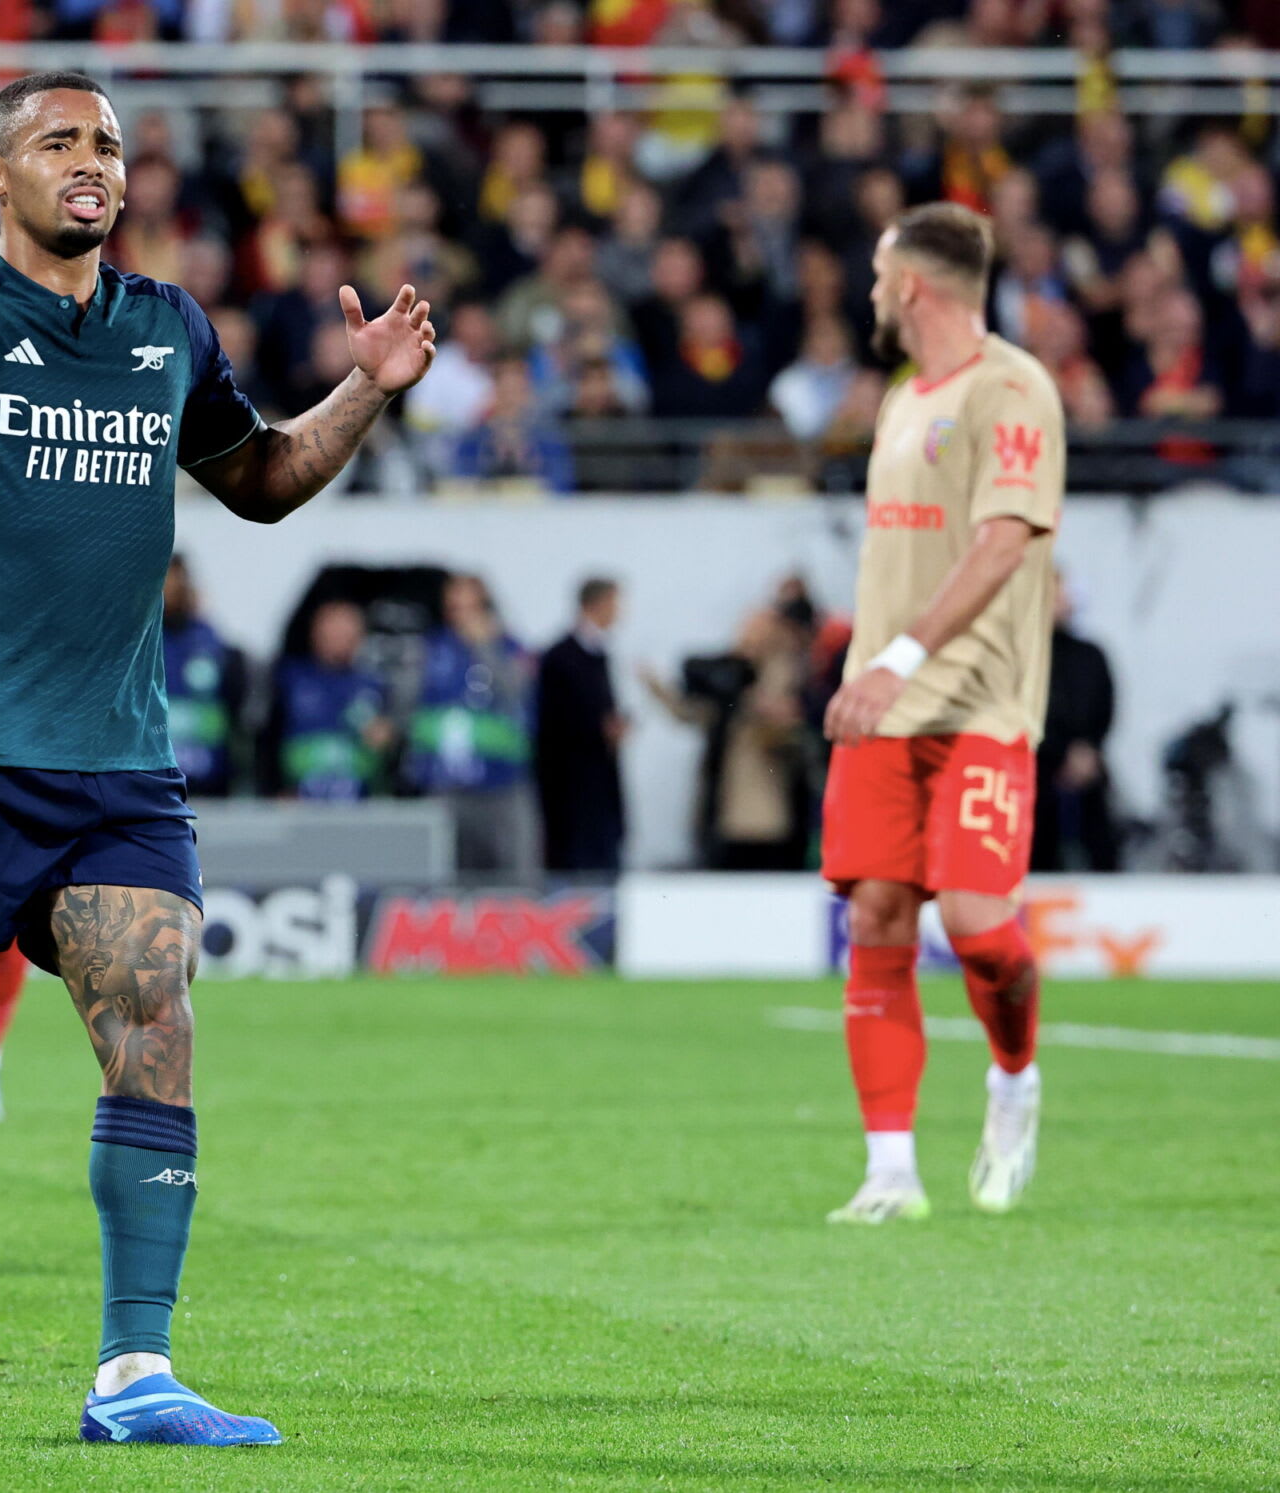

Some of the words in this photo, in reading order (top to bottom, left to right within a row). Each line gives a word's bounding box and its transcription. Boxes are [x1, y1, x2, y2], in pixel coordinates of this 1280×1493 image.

[25, 445, 68, 481] FLY
[74, 448, 153, 486] BETTER
[959, 765, 1019, 836] 24
